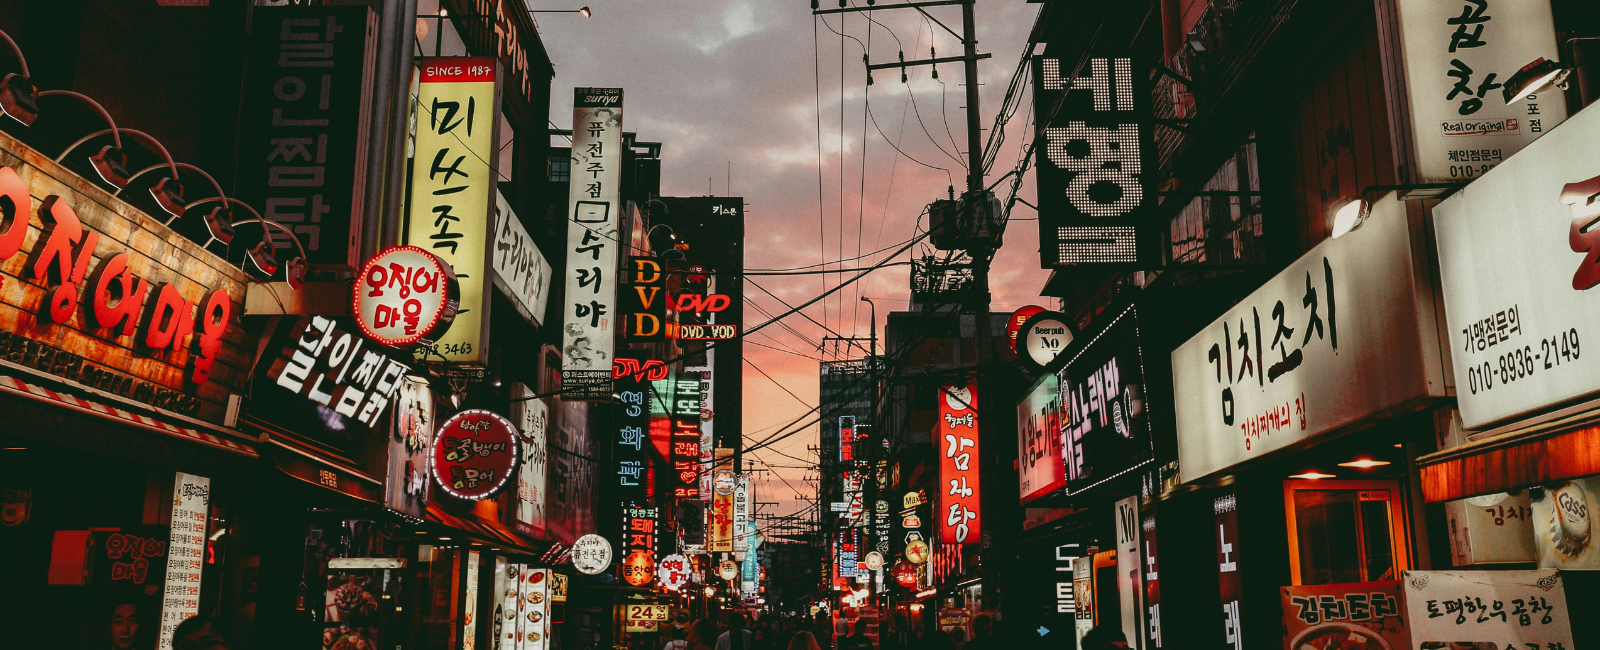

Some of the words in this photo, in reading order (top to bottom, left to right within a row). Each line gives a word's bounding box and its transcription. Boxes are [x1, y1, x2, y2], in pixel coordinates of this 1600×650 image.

[426, 66, 463, 77] SINCE
[467, 66, 492, 77] 1987
[1446, 0, 1503, 115] 곱창
[584, 94, 619, 107] suriya
[264, 15, 344, 251] 달인찜닭
[1441, 121, 1464, 132] Real
[585, 121, 605, 199] 퓨전주점
[1448, 149, 1503, 162] 체인점문의
[1450, 164, 1495, 178] 010-8
[428, 95, 473, 315] 미쓰족
[497, 210, 534, 296] 수리야
[366, 262, 440, 299] 오징어
[575, 229, 607, 328] 수리야
[633, 259, 661, 337] DVD
[675, 294, 731, 312] DVD
[373, 299, 422, 336] 마을
[1035, 326, 1051, 335] Beer
[1051, 326, 1065, 336] pub
[1462, 304, 1522, 354] 가맹점문의
[444, 342, 472, 355] 3463
[1208, 256, 1338, 426] 김치조치
[277, 315, 407, 428] 달인찜닭
[612, 357, 669, 383] DVD
[1468, 327, 1581, 396] 010-8936-2149
[1240, 402, 1291, 450] 김치찌개의
[1295, 392, 1306, 431] 집
[905, 496, 920, 505] Max
[945, 434, 977, 543] 감자탕
[1558, 491, 1587, 519] Cass
[630, 508, 655, 518] 영등포
[1119, 503, 1136, 544] No
[105, 533, 166, 559] 오징어
[111, 557, 150, 584] 마을
[624, 564, 653, 577] 품앗이
[1219, 523, 1243, 650] 노래
[1409, 575, 1429, 588] Cass
[1536, 574, 1558, 589] Cass
[1145, 540, 1162, 648] 노래
[1290, 592, 1400, 625] 김치조치
[631, 605, 654, 619] 24
[1425, 596, 1508, 625] 토평한우
[1511, 595, 1554, 628] 곱창
